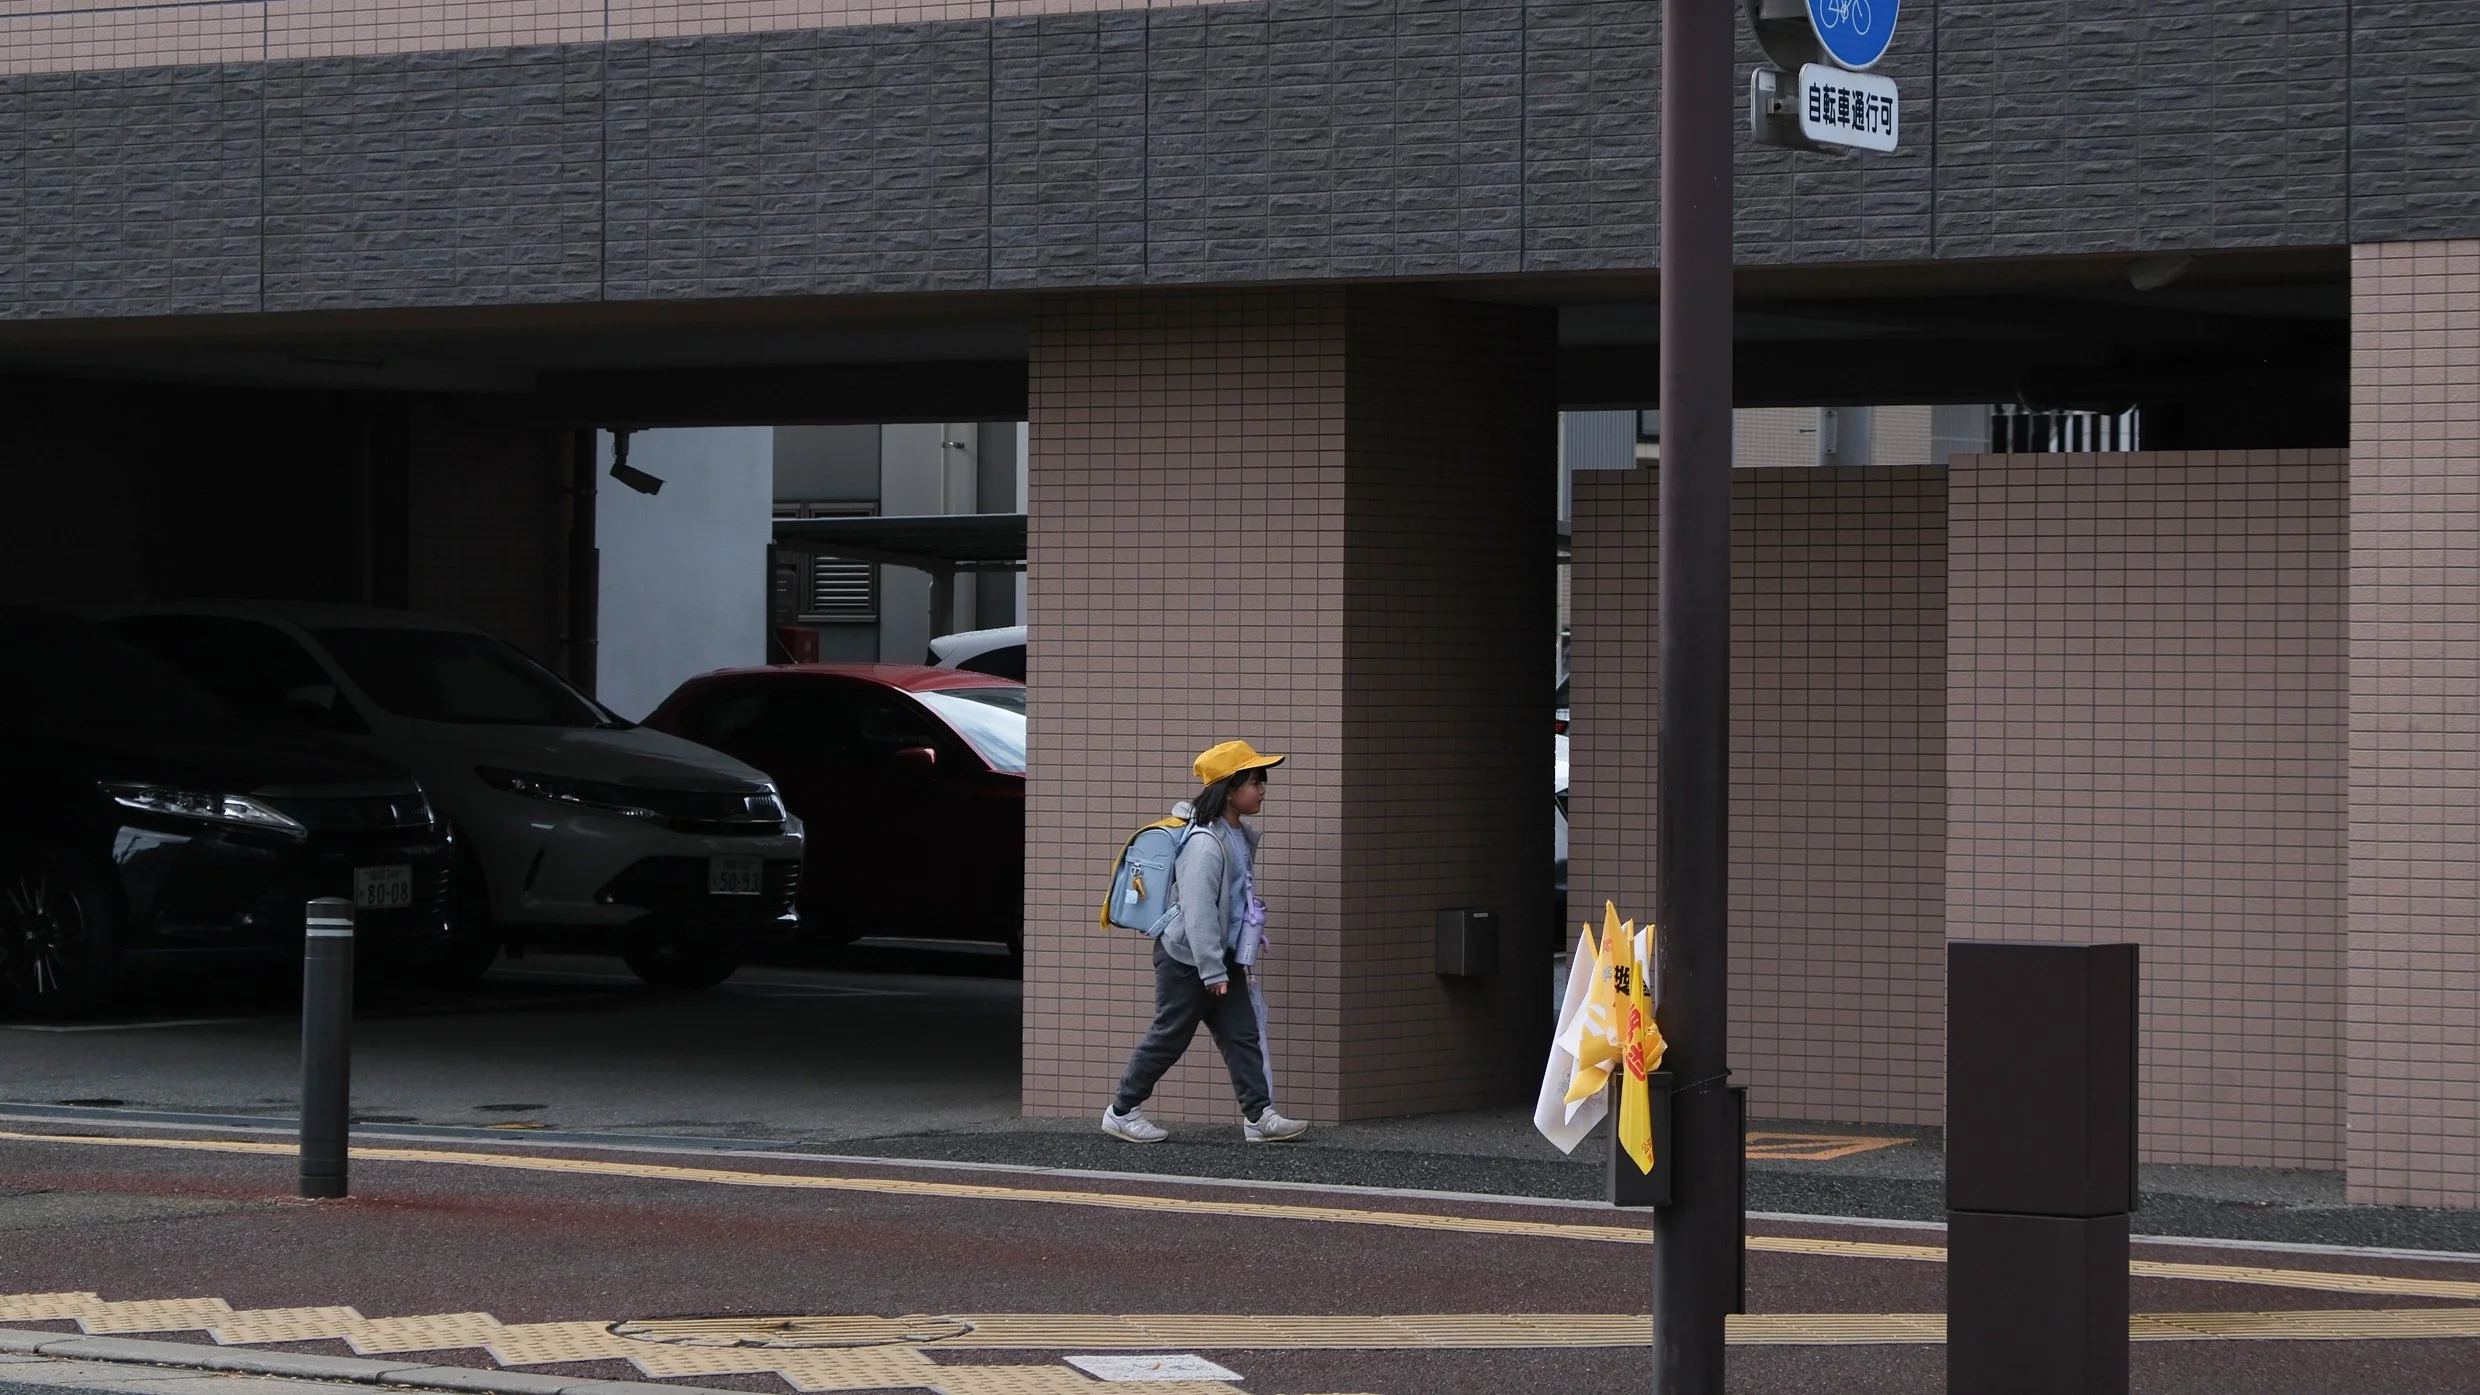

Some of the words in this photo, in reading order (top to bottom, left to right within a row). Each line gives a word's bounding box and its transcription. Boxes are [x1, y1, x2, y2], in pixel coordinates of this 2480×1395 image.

[1809, 82, 1893, 136] 自転車通行可
[367, 881, 408, 904] 80-08
